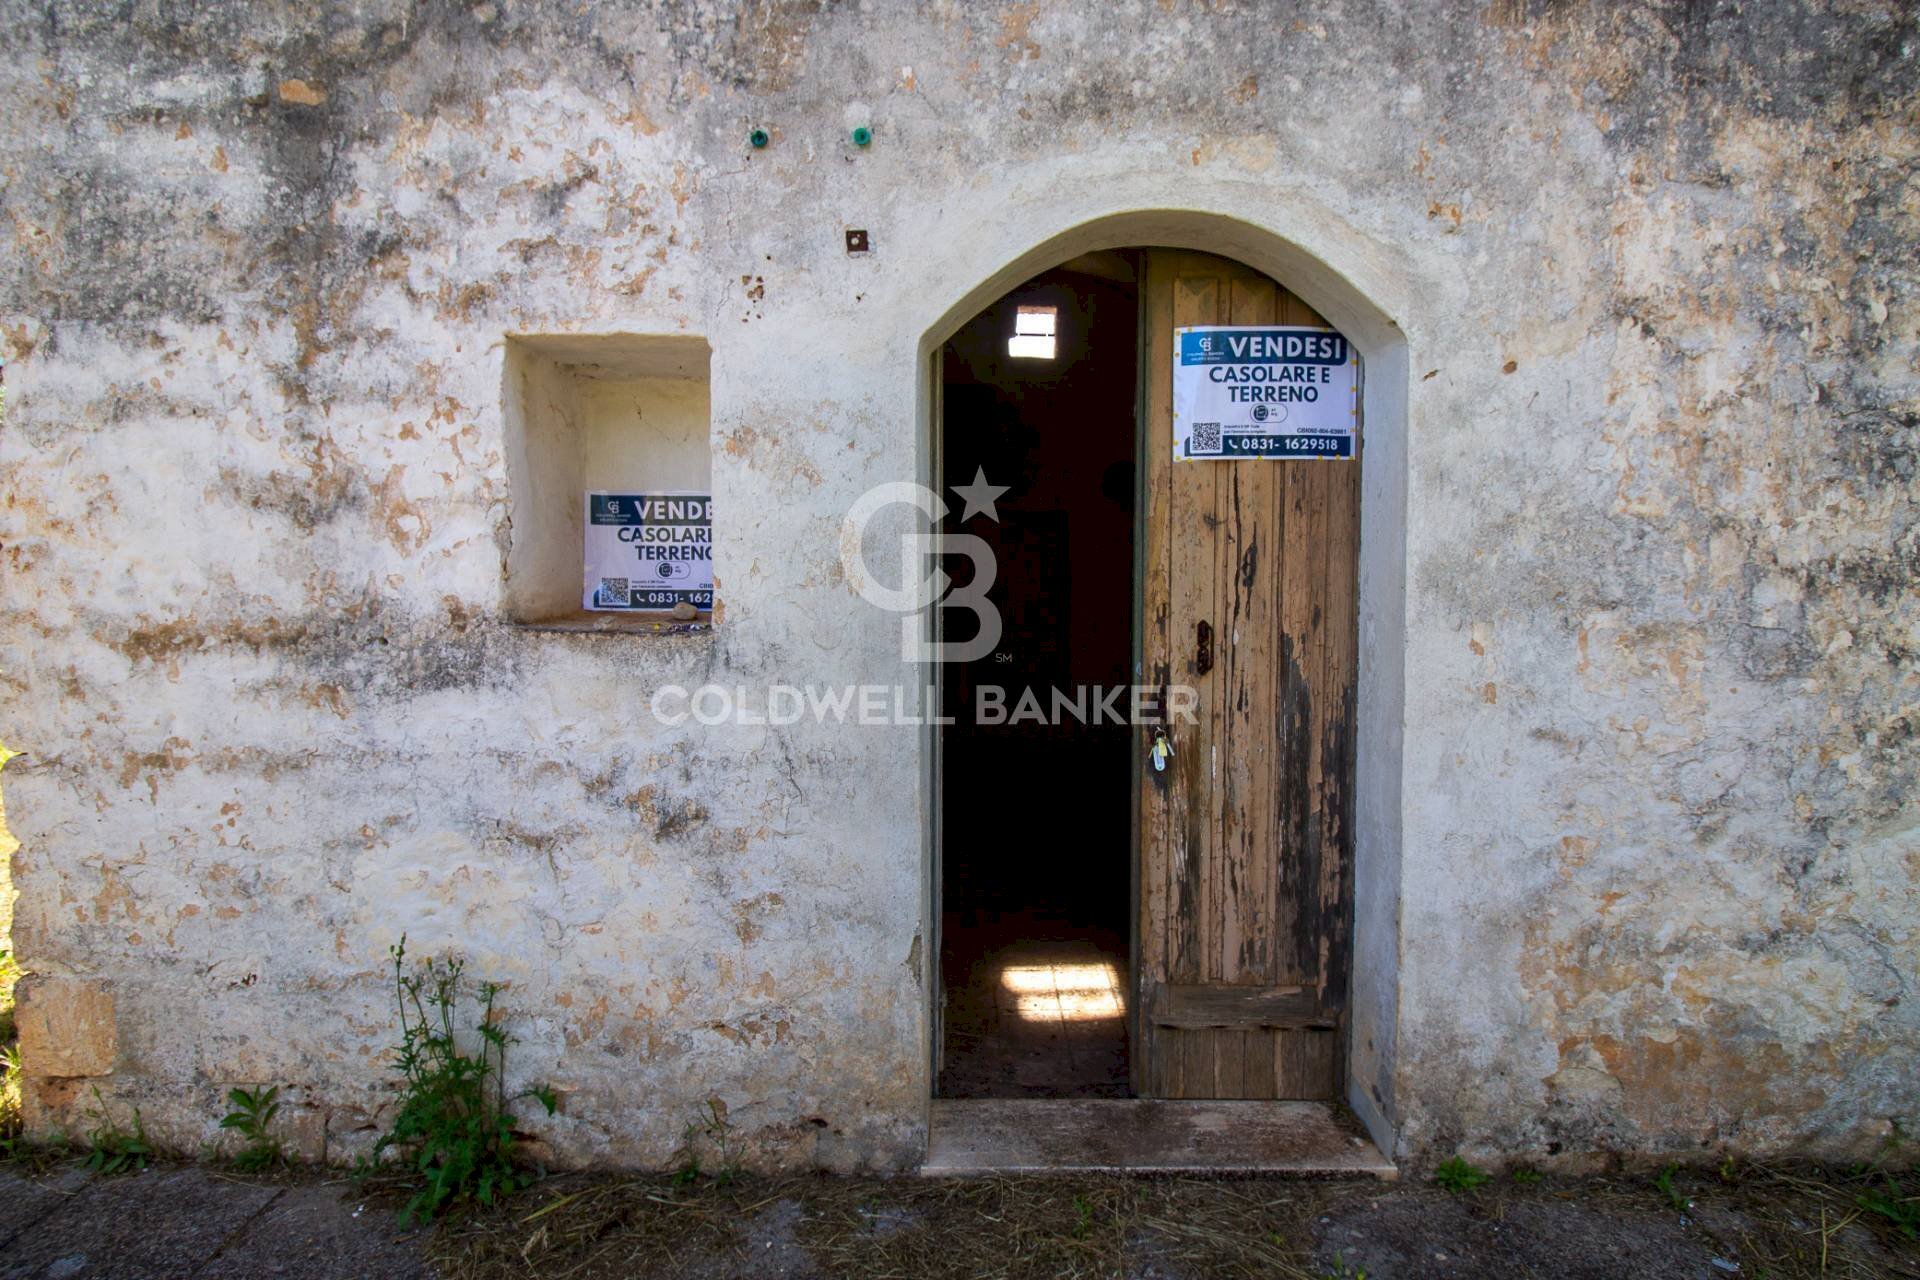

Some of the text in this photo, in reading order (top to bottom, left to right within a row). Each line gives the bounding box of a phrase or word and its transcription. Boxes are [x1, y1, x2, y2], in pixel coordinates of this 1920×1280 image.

[1228, 336, 1341, 359] VENDESI
[1209, 366, 1330, 383] CASOLARE E
[1228, 386, 1319, 402] TERRENO
[1241, 438, 1338, 450] 0831- 1629518
[648, 592, 684, 603] 0831-
